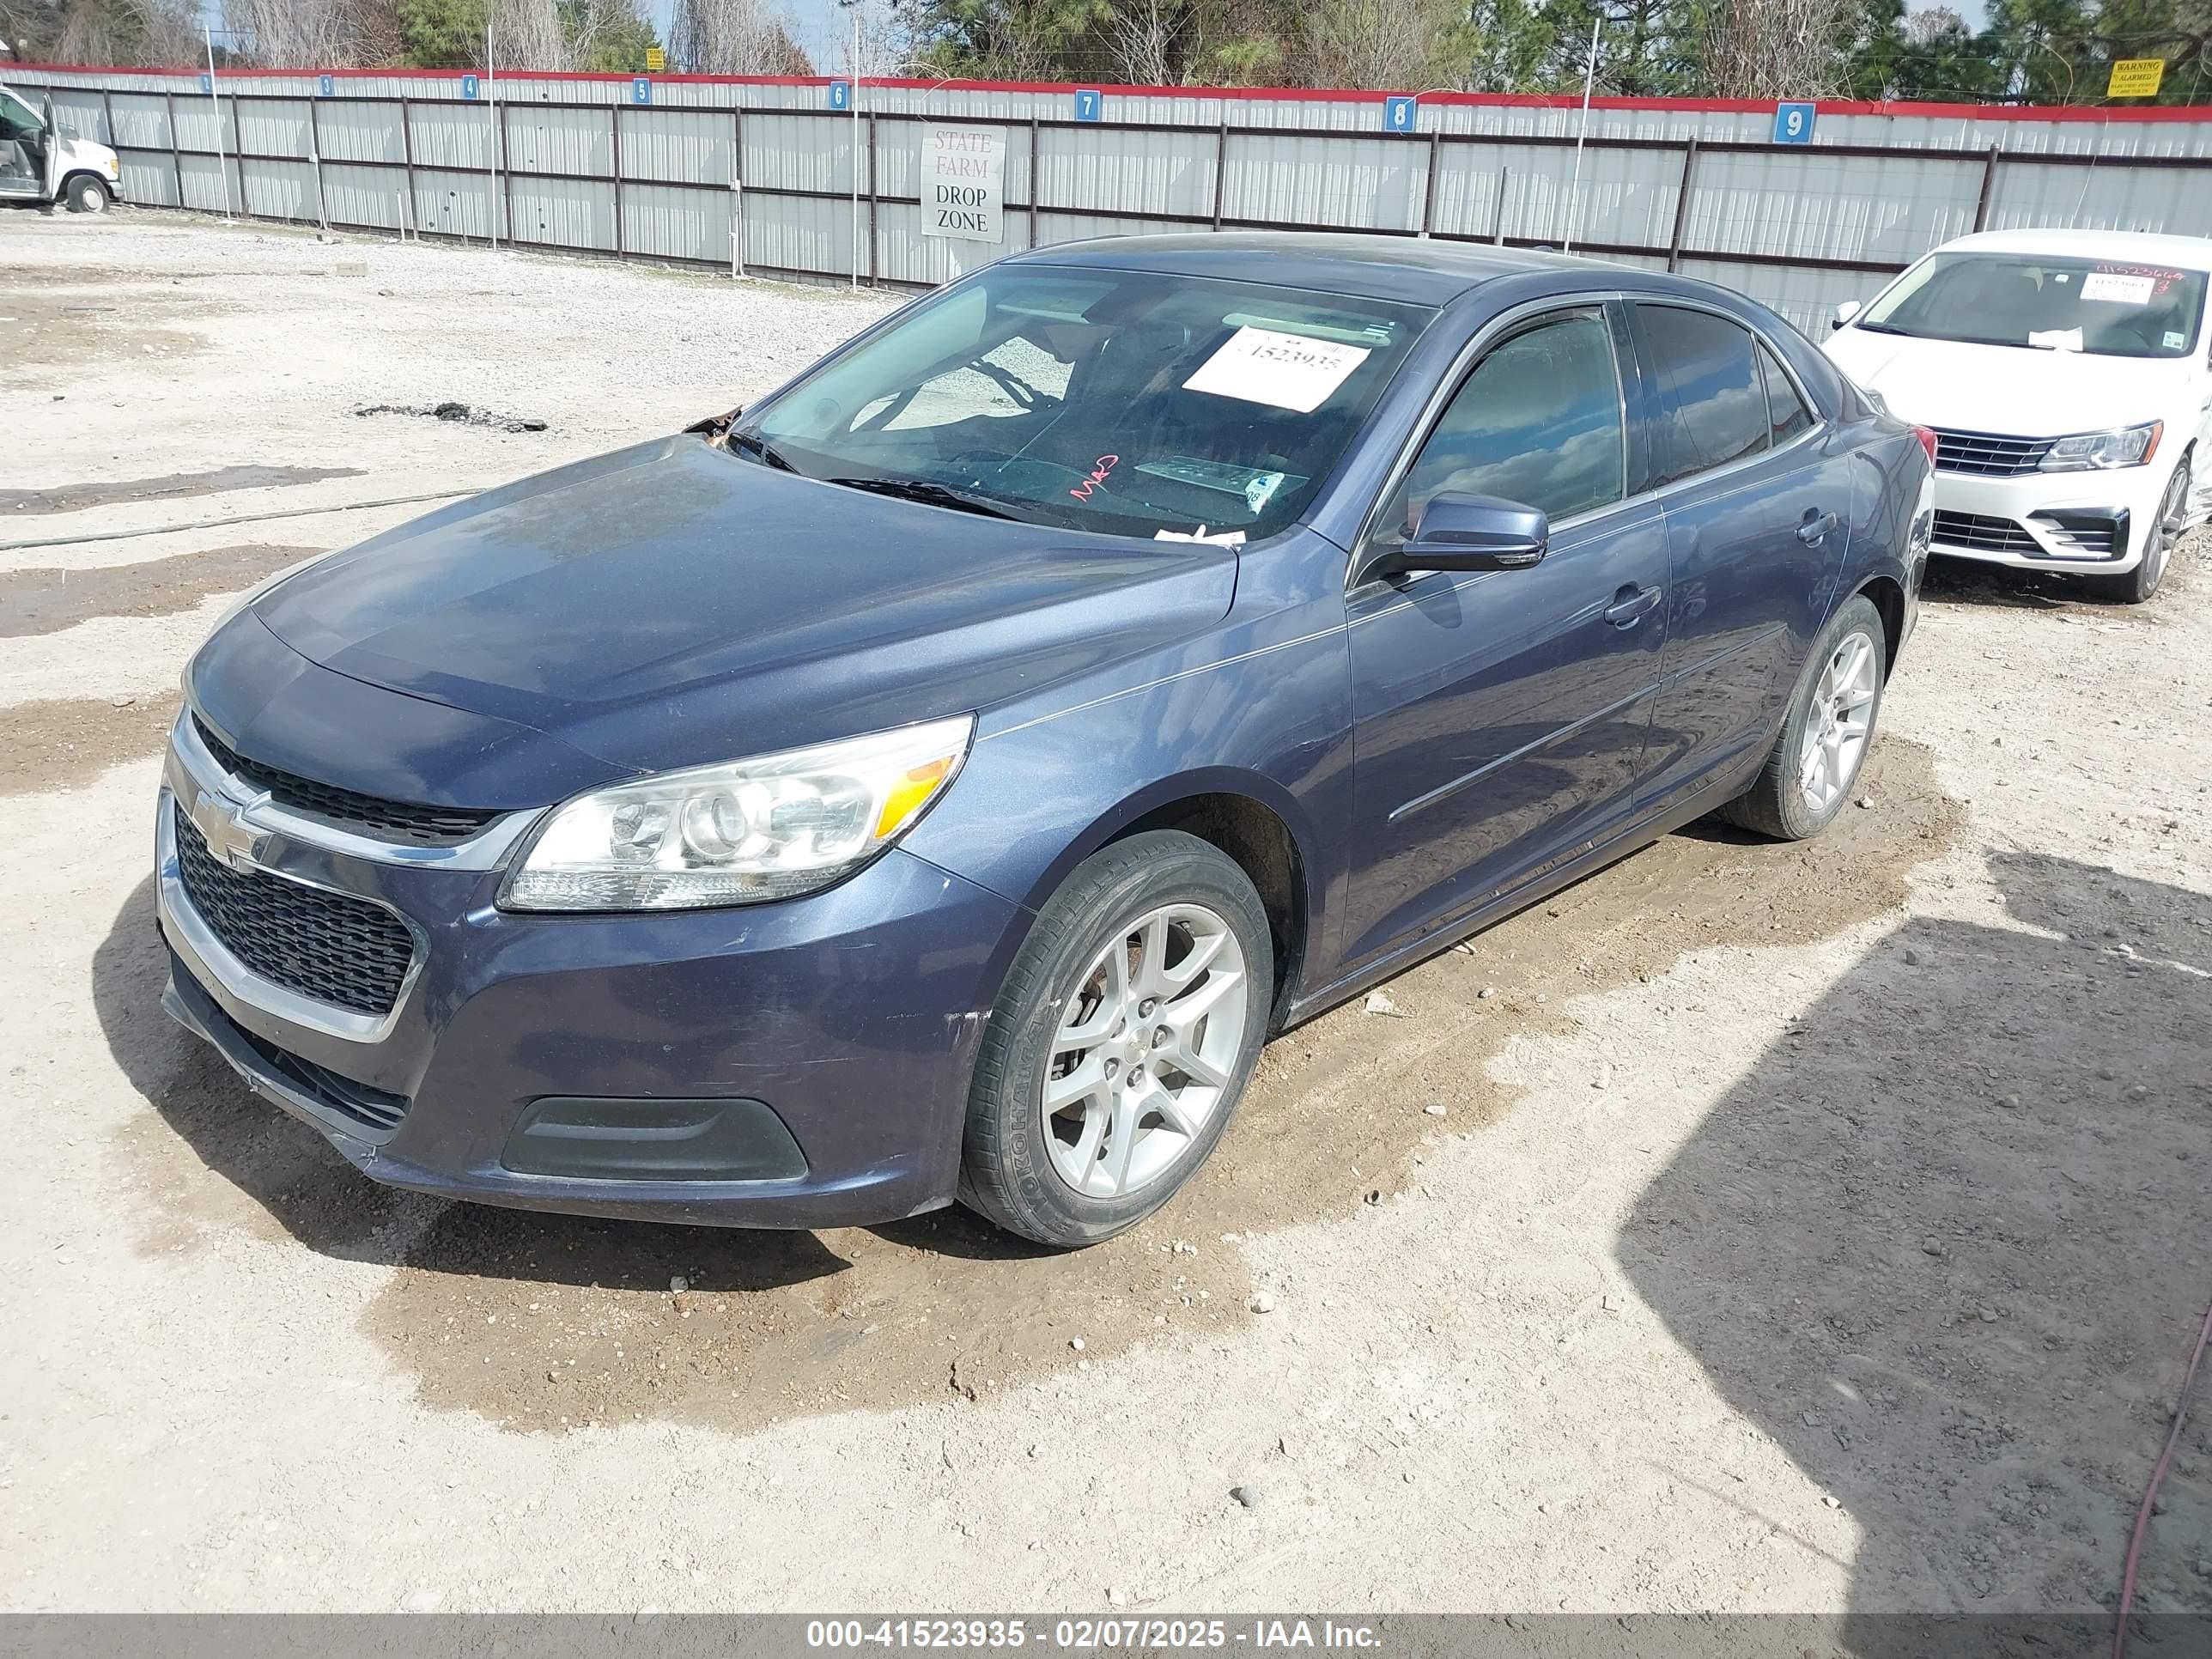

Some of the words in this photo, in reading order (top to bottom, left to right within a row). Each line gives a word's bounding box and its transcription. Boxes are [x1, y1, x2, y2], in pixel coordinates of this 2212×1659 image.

[2117, 62, 2159, 70] WARNING
[324, 78, 330, 93] 3
[466, 79, 473, 94] 4
[639, 82, 646, 100] 5
[835, 87, 842, 105] 6
[1083, 95, 1092, 115] 7
[1394, 103, 1406, 125] 8
[1787, 111, 1802, 136] 9
[934, 129, 992, 153] STATE
[935, 155, 988, 179] FARM
[935, 184, 987, 207] DROP
[937, 209, 988, 233] ZONE
[1247, 490, 1261, 502] 08
